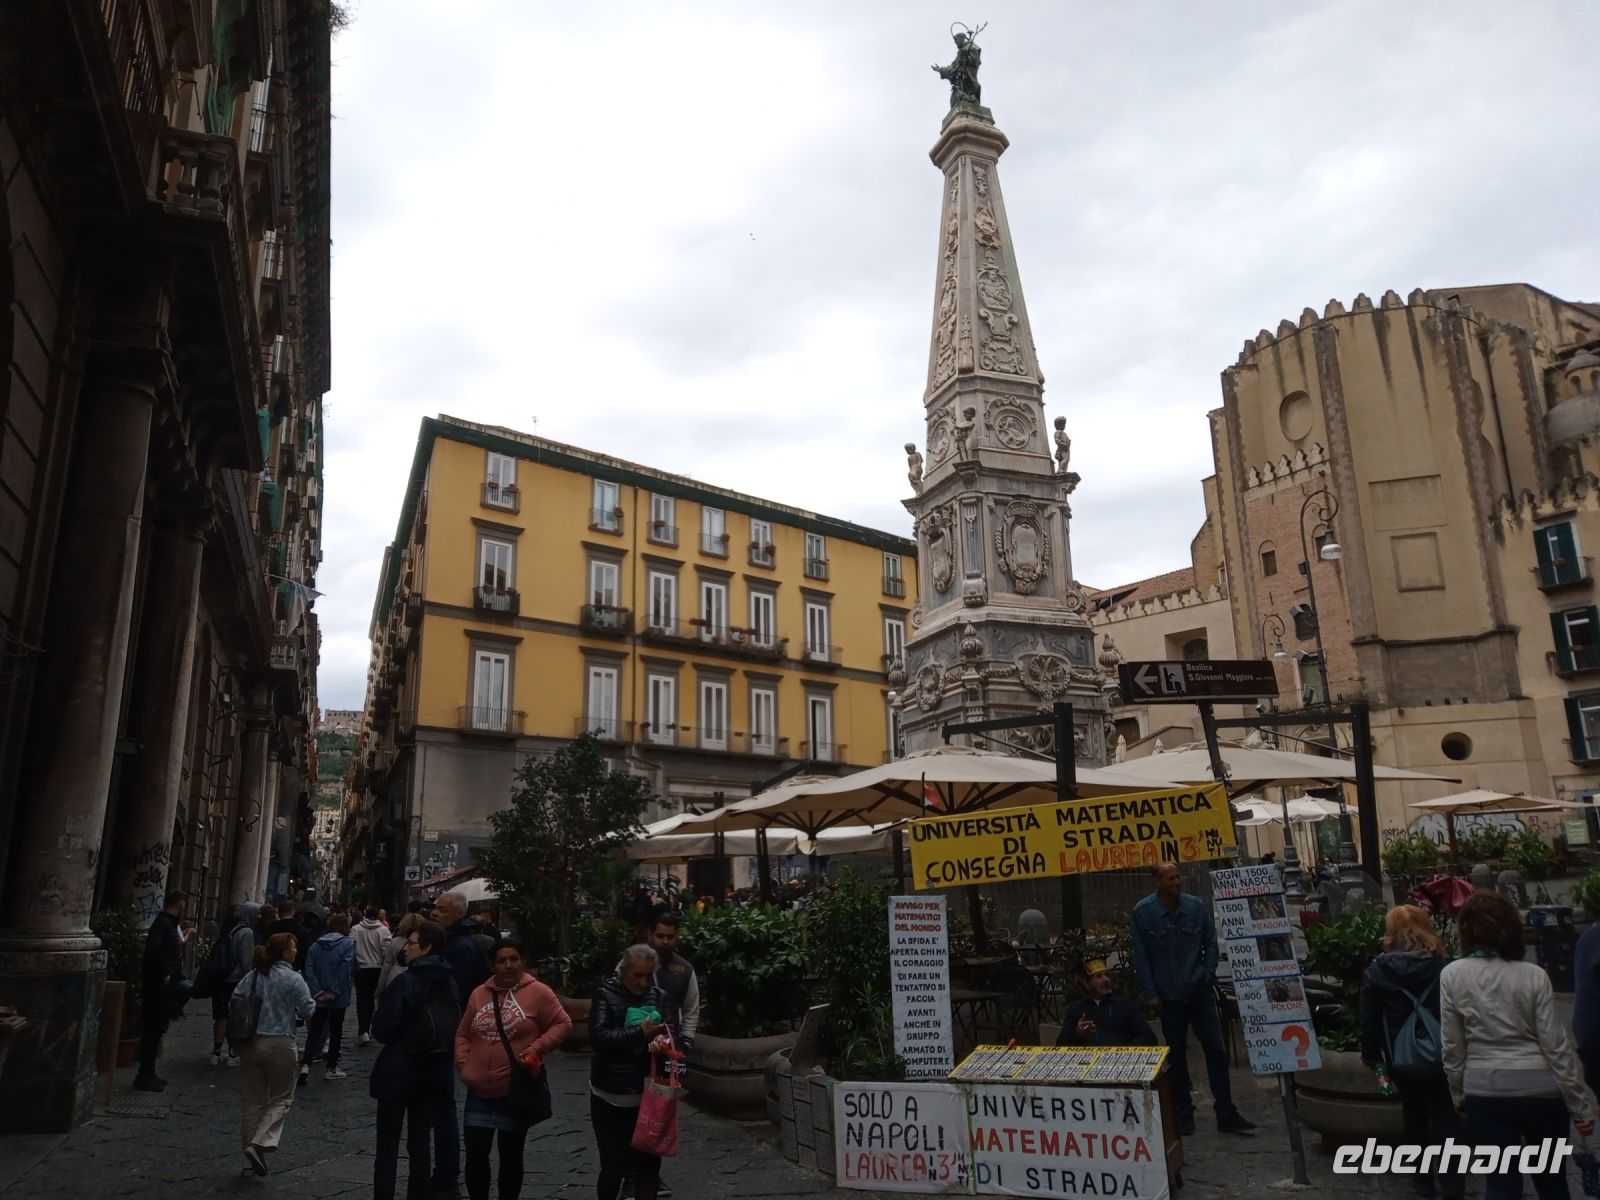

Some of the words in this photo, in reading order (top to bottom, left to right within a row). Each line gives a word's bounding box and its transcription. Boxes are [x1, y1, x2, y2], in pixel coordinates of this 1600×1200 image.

[1186, 663, 1213, 672] Basilica
[1226, 674, 1254, 683] Maggiore
[912, 808, 1041, 842] UNIVERSITÀ
[1055, 792, 1212, 826] MATEMATICA
[1003, 836, 1028, 855] DI
[1063, 821, 1174, 848] STRADA
[926, 852, 1046, 882] CONSEGNA
[1058, 841, 1158, 873] LAUREA
[1161, 840, 1180, 864] IN
[1216, 870, 1241, 880] OGNI
[1246, 867, 1268, 878] 1500
[1214, 880, 1237, 890] ANNI
[1240, 875, 1275, 887] NASCE
[1221, 889, 1234, 898] UN
[1239, 886, 1271, 898] GENIO
[895, 902, 923, 910] AVVISO
[925, 903, 940, 911] PER
[1222, 904, 1243, 913] 1500
[895, 913, 941, 921] MATEMATICI
[1221, 917, 1244, 927] ANNI
[1252, 921, 1288, 930] PITAGORA
[911, 924, 941, 932] MONDO
[1227, 927, 1247, 937] A.C.
[897, 937, 906, 945] LA
[908, 937, 930, 945] SFIDA
[890, 948, 919, 956] APERTA
[920, 948, 935, 956] CHI
[936, 948, 947, 956] HA
[1230, 944, 1252, 954] 1500
[1231, 958, 1255, 969] ANNI
[908, 972, 928, 980] FARE
[929, 972, 941, 980] UN
[1234, 969, 1256, 979] D.C.
[894, 984, 936, 992] TENTATIVO
[906, 995, 936, 1003] FACCIA
[907, 1009, 936, 1017] AVANTI
[903, 1021, 931, 1029] ANCHE
[932, 1020, 941, 1028] IN
[1249, 1026, 1265, 1034] DAL
[906, 1032, 940, 1040] GRUPPO
[902, 1046, 935, 1054] ARMATO
[937, 1046, 946, 1054] DI
[903, 1057, 943, 1066] OMPUTER
[945, 1057, 950, 1065] E
[845, 1091, 893, 1119] SOLO
[905, 1096, 918, 1121] A
[969, 1095, 1140, 1124] UNIVERSITÀ
[846, 1122, 944, 1152] NAPOLI
[971, 1127, 1152, 1162] MATEMATICA
[845, 1152, 927, 1182] LAUREA
[977, 1162, 1002, 1187] DI
[1026, 1167, 1139, 1198] STRADA
